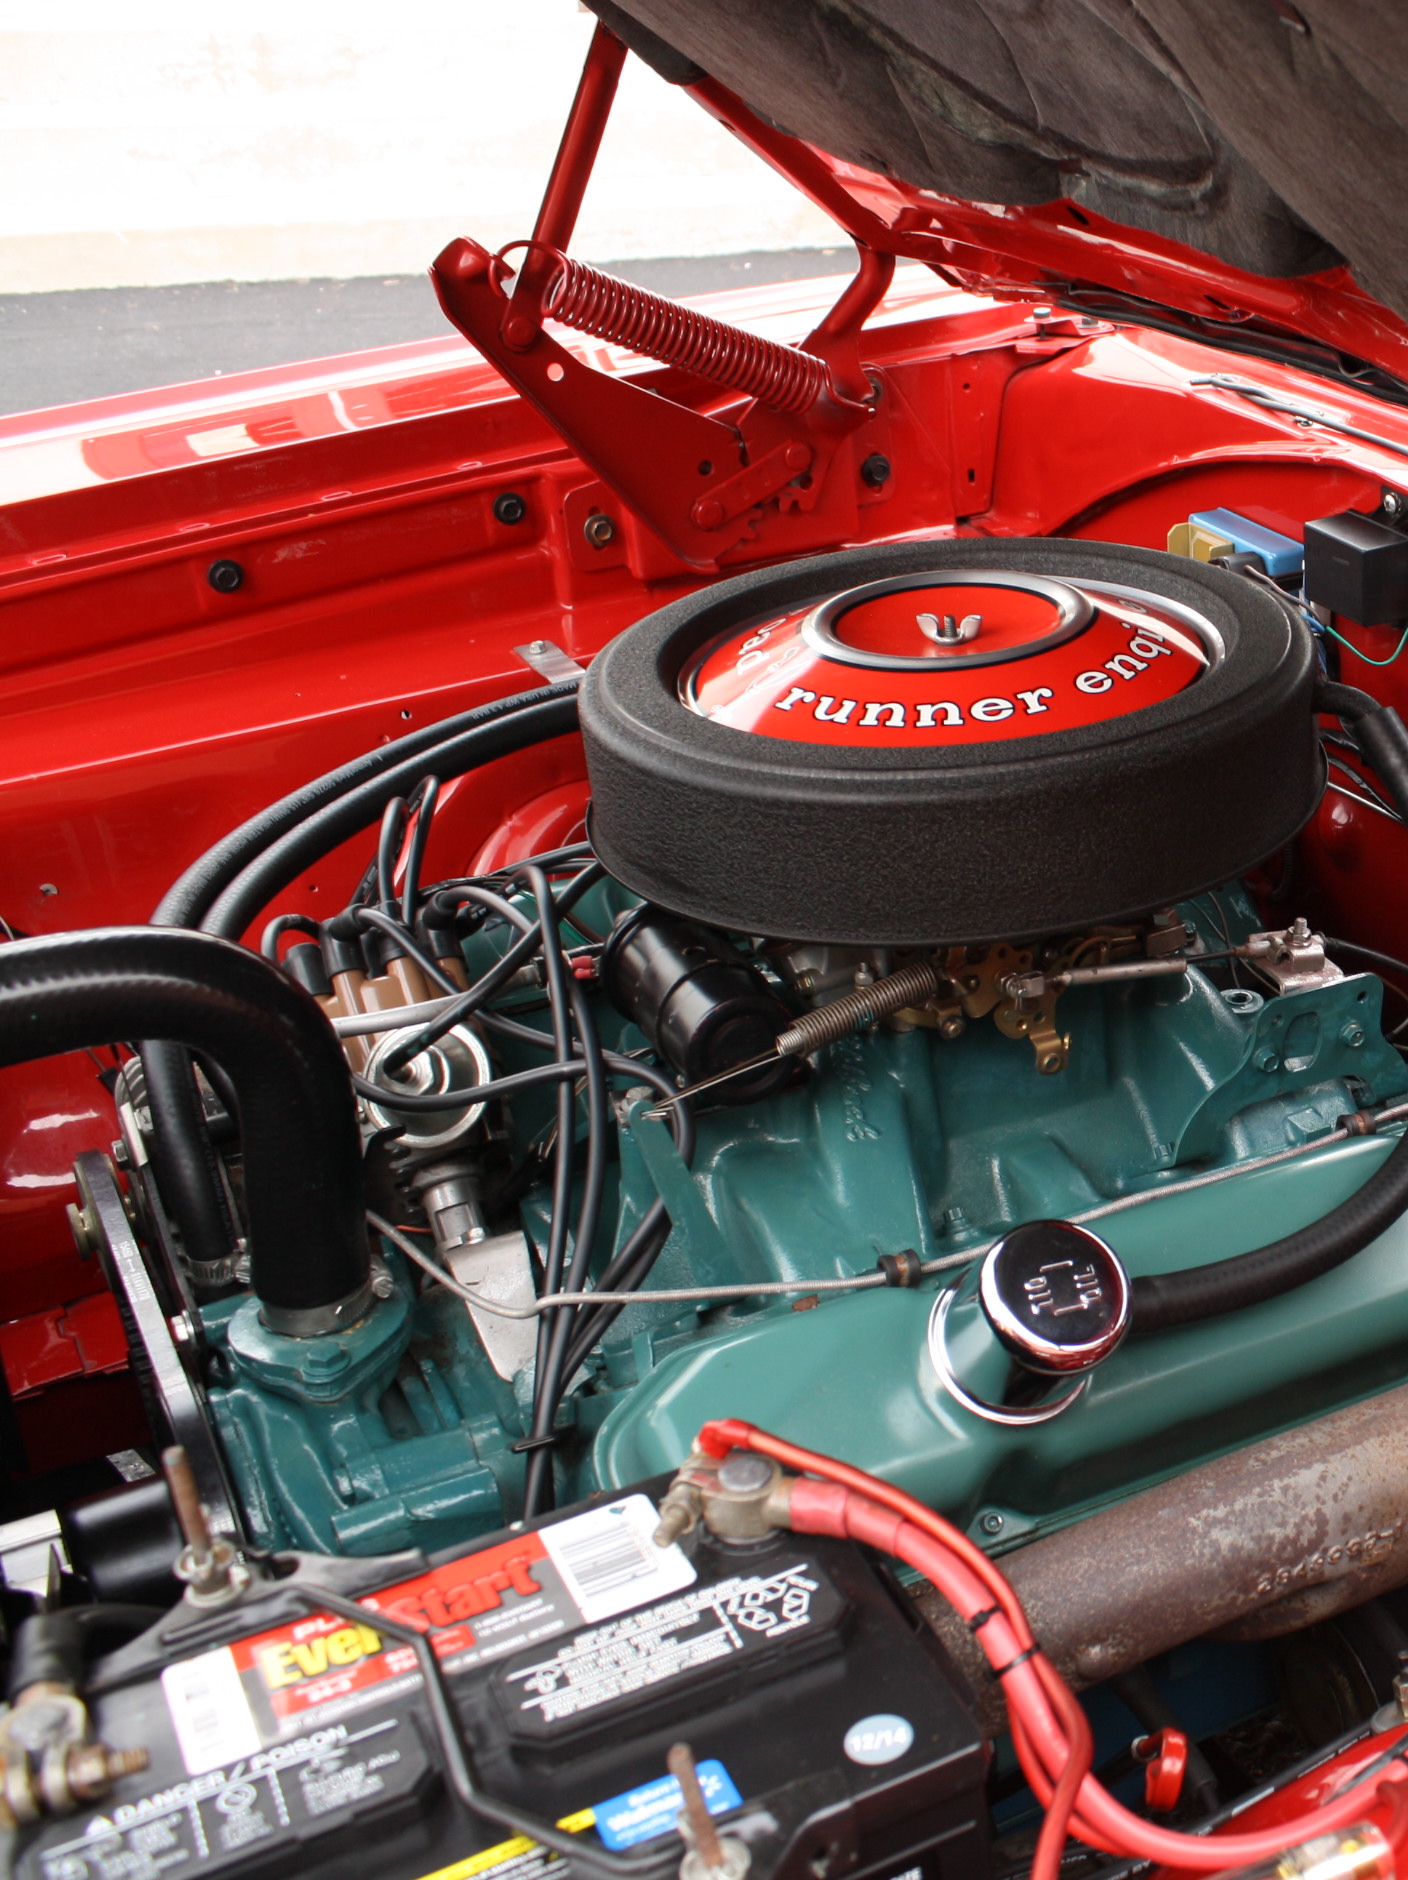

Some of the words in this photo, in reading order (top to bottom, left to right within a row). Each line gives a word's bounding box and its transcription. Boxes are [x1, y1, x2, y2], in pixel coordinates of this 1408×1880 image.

[774, 685, 1055, 729] runner
[1024, 1276, 1054, 1315] OIL
[1073, 1263, 1102, 1304] OIL
[293, 1598, 382, 1640] PLS
[113, 1771, 226, 1826] DANGER
[250, 1724, 348, 1772] POISON
